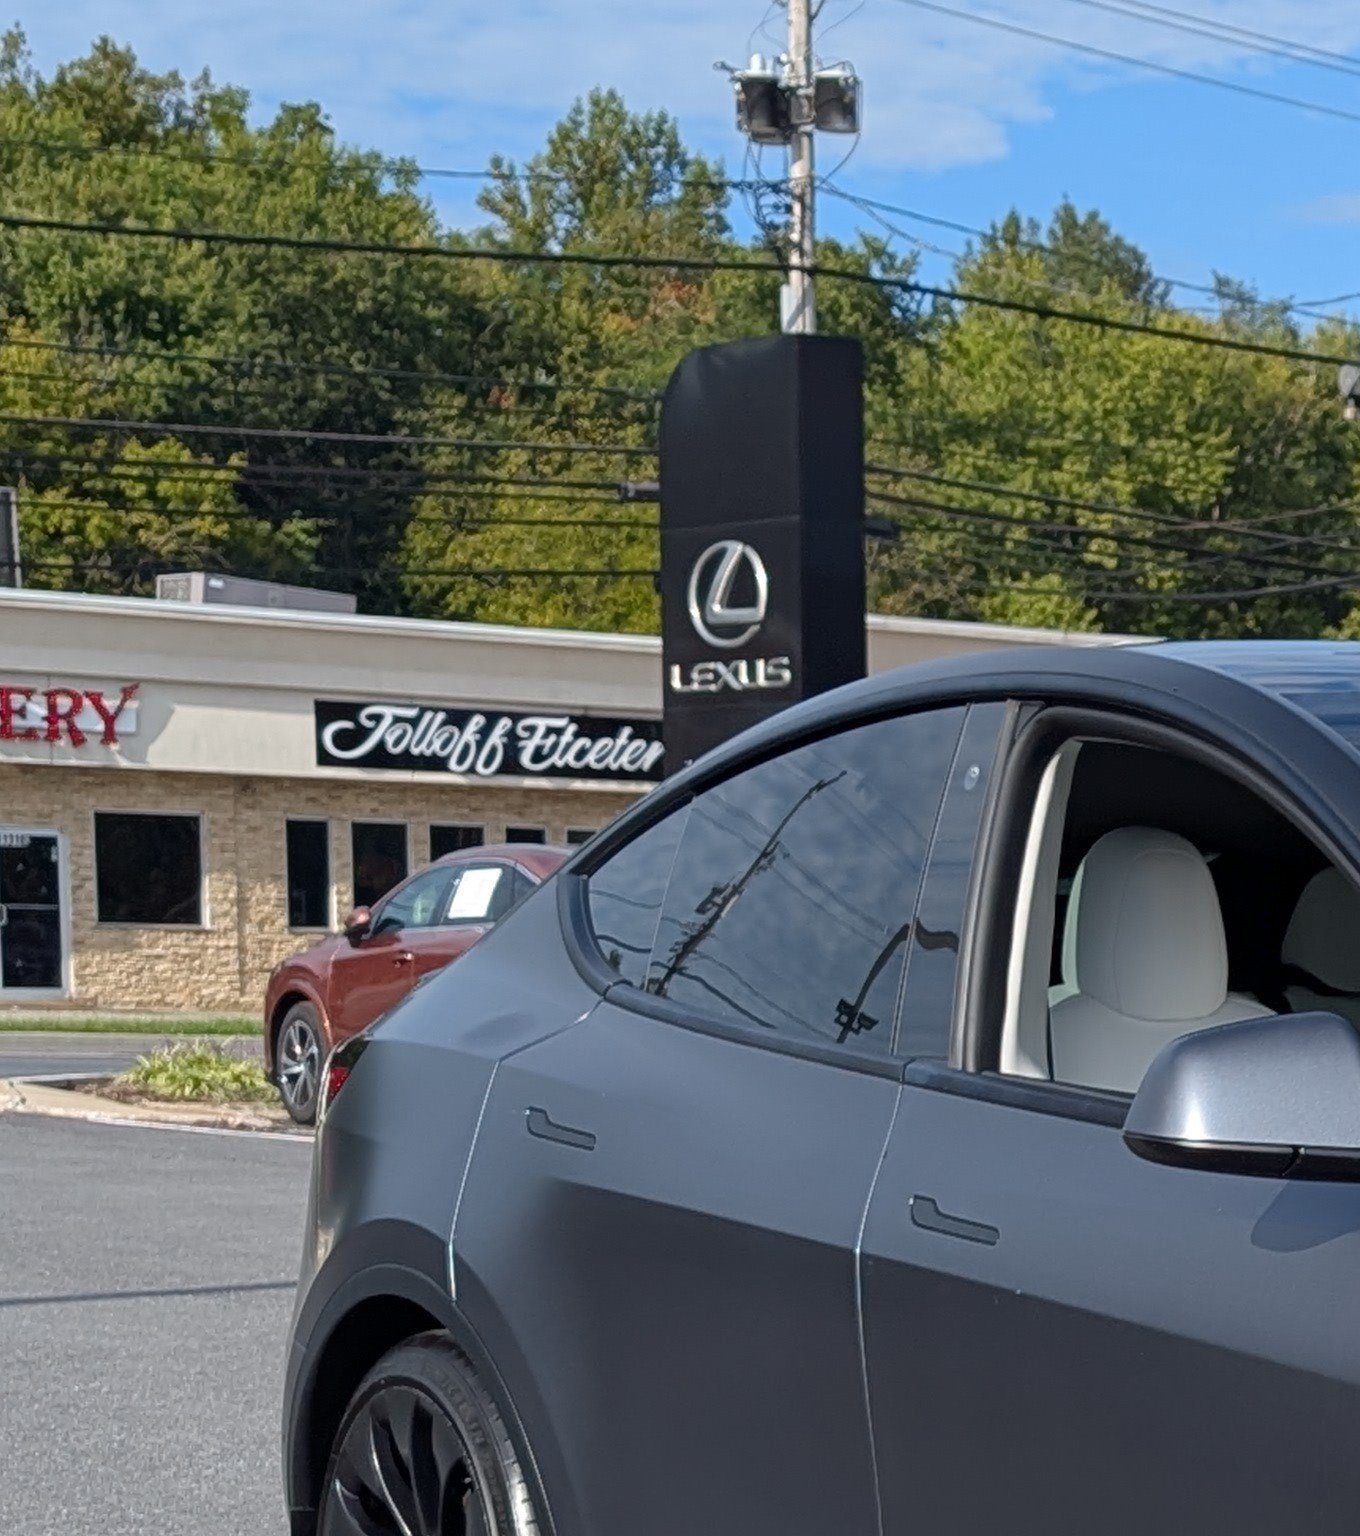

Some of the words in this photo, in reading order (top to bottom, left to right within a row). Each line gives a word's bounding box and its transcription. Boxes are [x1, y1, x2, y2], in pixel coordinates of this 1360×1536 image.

[670, 656, 792, 693] LEXUS
[0, 682, 140, 748] ERY
[515, 716, 666, 773] Etceter
